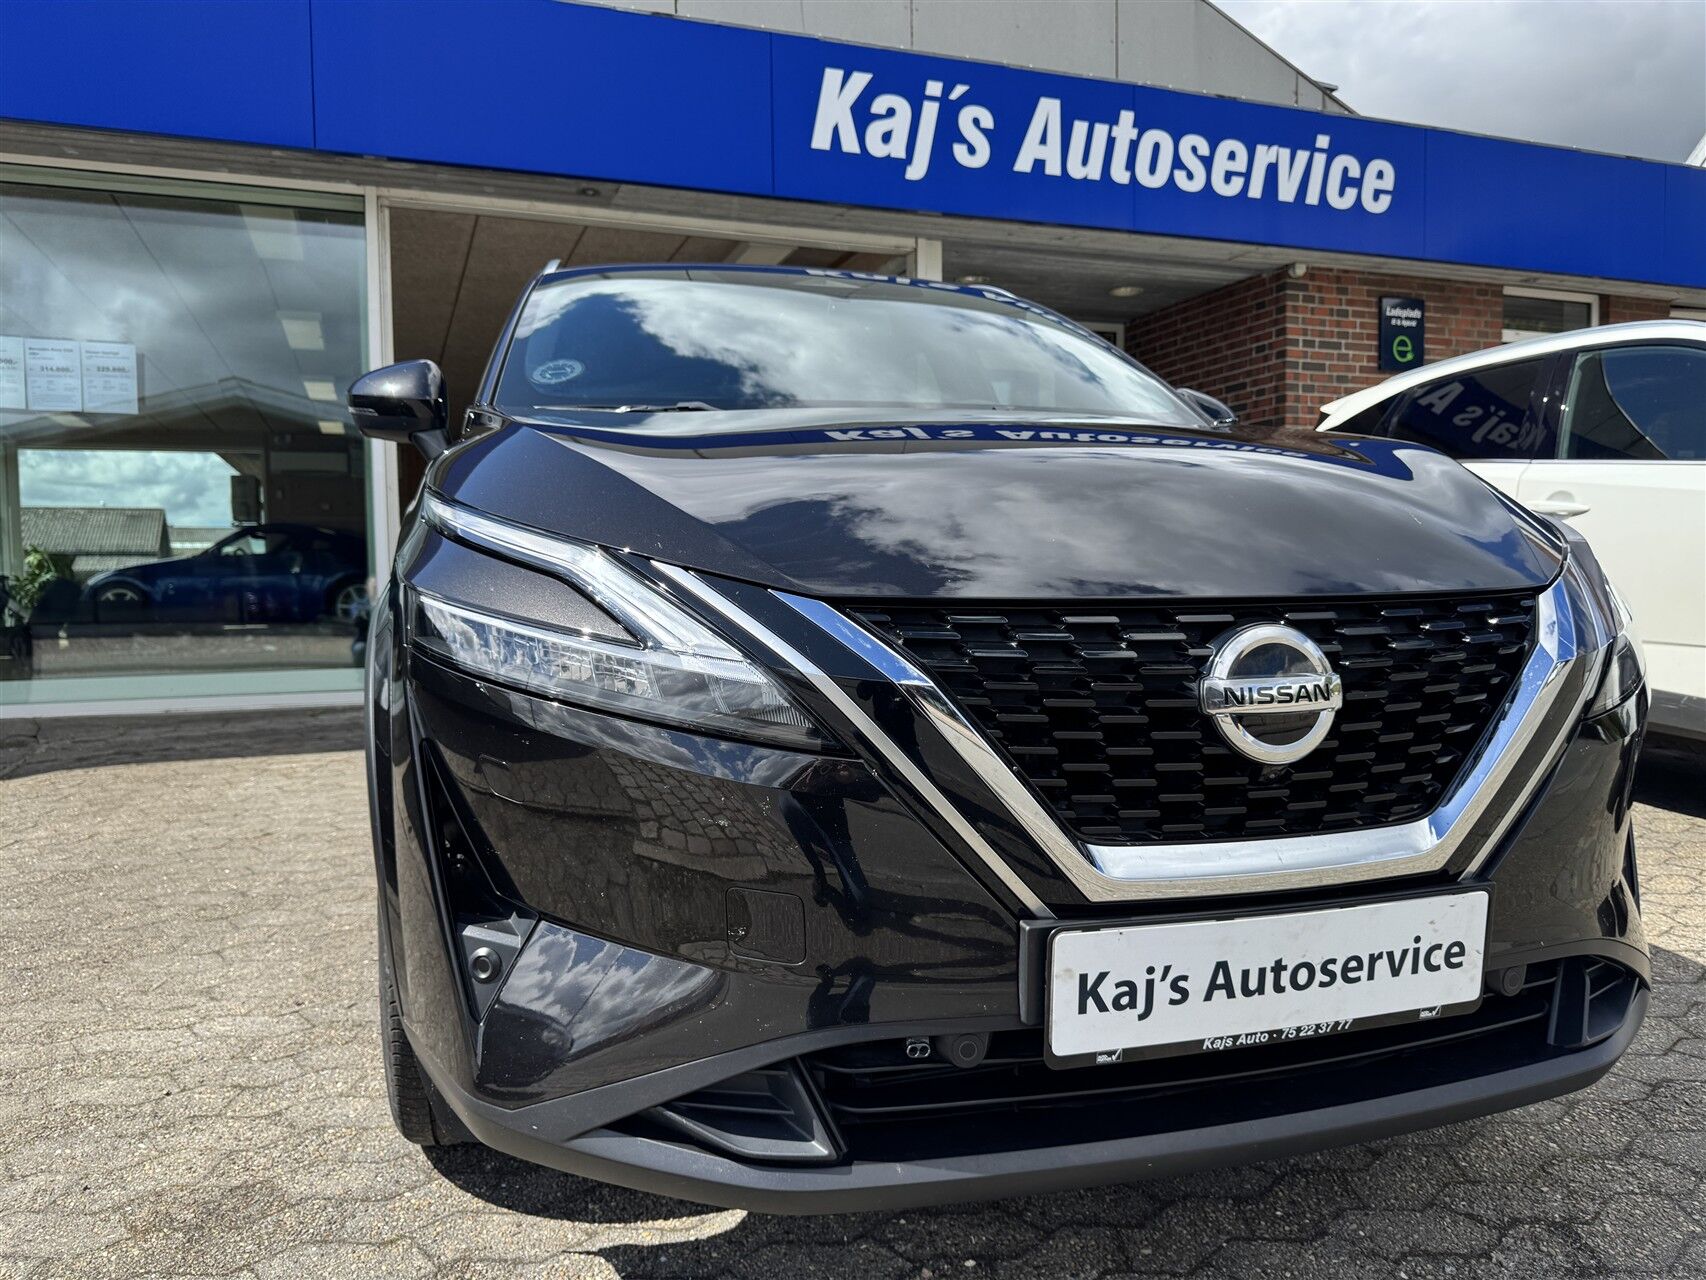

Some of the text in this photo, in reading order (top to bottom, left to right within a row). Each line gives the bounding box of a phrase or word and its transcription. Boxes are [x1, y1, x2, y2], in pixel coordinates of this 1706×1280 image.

[1013, 96, 1396, 215] Autoservice
[1223, 683, 1331, 706] NISSAN
[1077, 935, 1466, 1021] Kaj's Autoservice
[1202, 1036, 1233, 1050] Kajs
[1236, 1032, 1269, 1046] Auto
[1281, 1027, 1296, 1039] 75
[1299, 1024, 1316, 1036] 22
[1318, 1021, 1335, 1033] 37
[1337, 1019, 1353, 1031] 77
